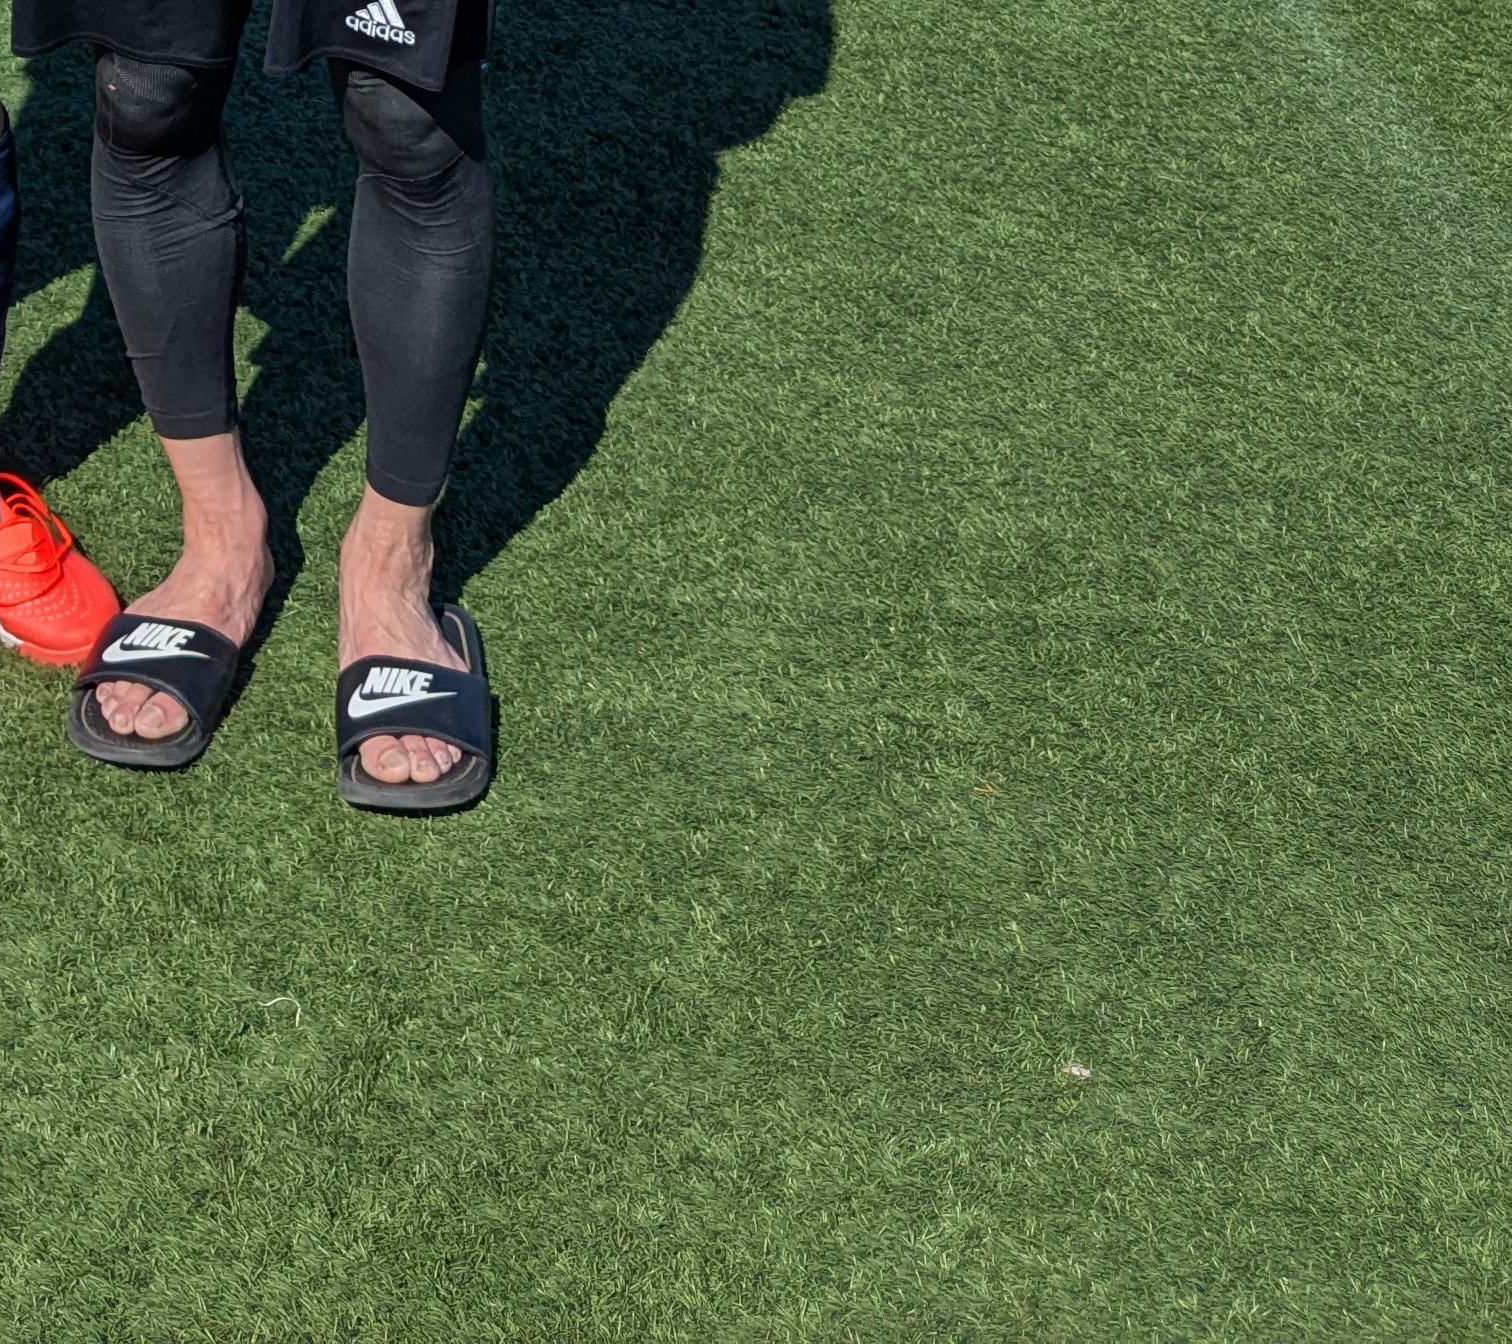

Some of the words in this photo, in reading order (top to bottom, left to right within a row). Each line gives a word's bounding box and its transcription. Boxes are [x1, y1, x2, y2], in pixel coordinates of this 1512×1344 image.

[345, 15, 416, 46] adidas
[122, 622, 196, 651] NIKE
[361, 667, 434, 696] NIKE
